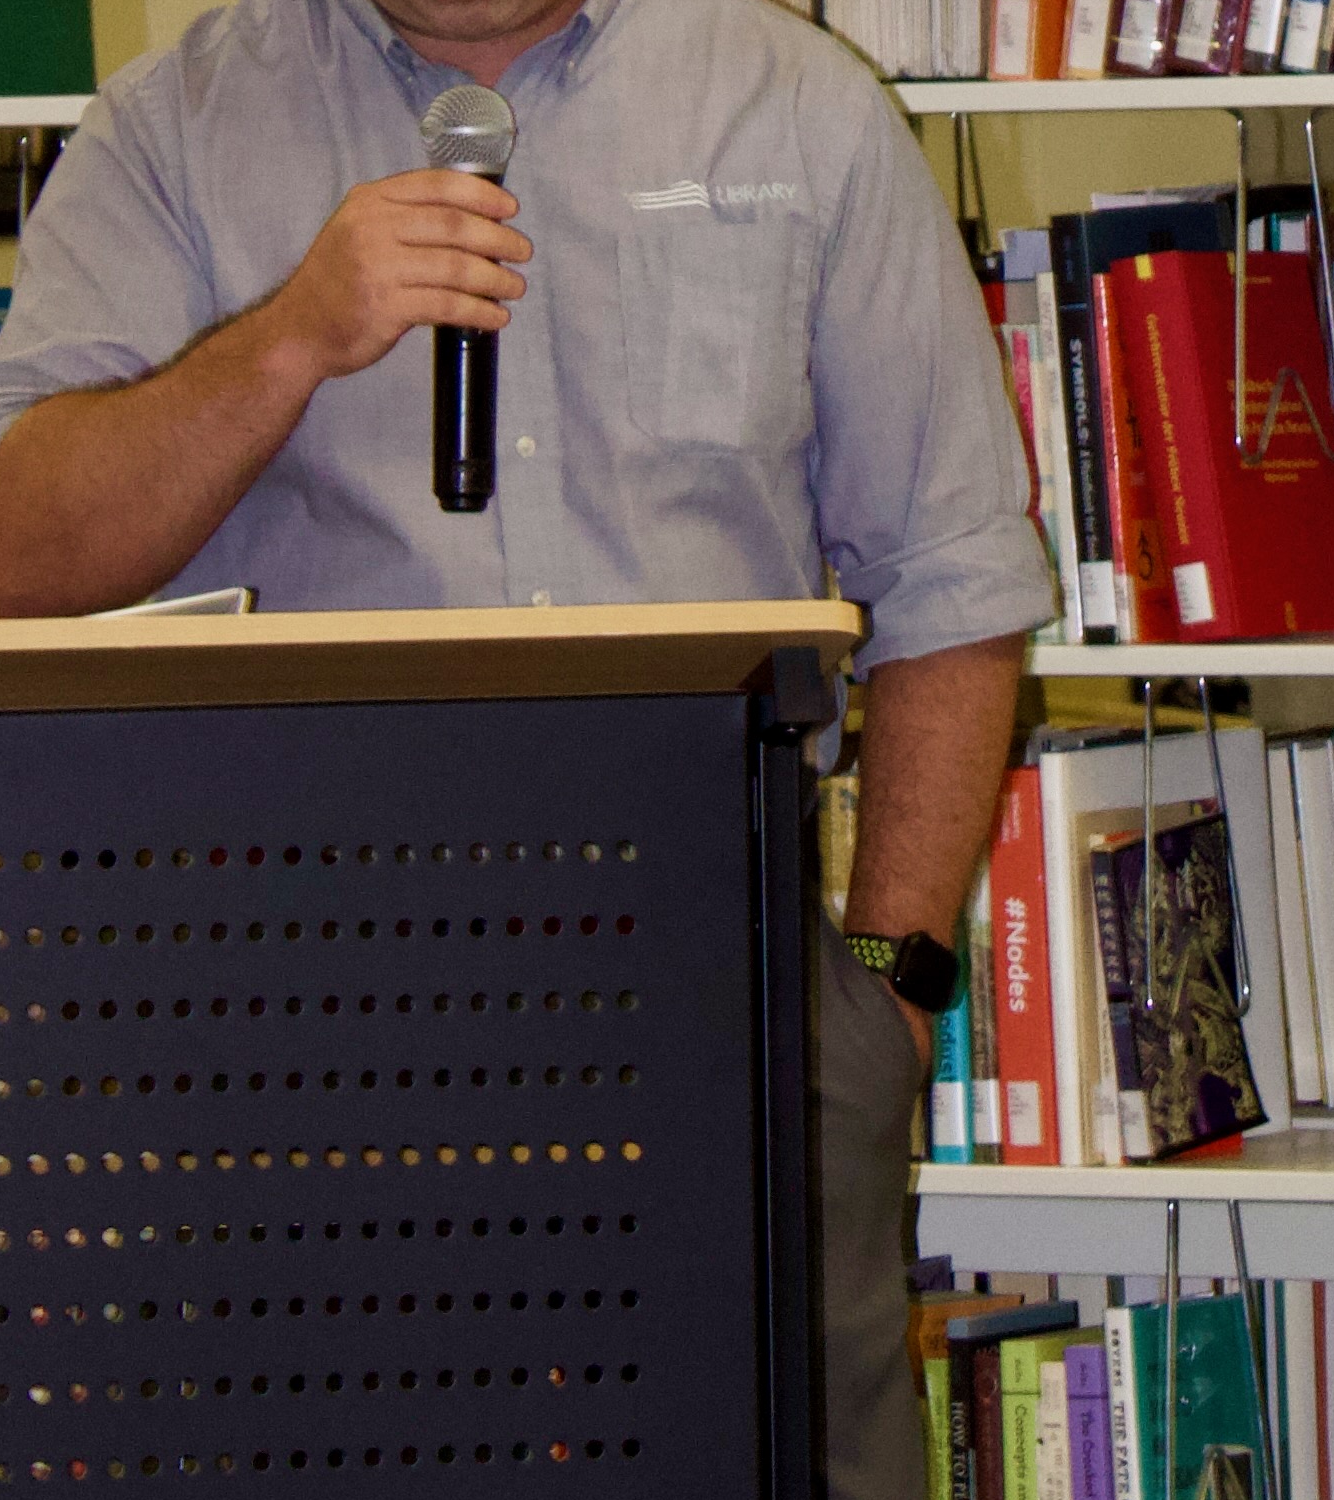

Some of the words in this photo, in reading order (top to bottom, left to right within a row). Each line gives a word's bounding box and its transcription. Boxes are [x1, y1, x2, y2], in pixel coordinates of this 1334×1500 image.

[1005, 898, 1029, 1012] #Nodes
[1013, 1405, 1029, 1479] Concepts
[1113, 1402, 1128, 1442] THE
[1115, 1446, 1130, 1494] FATE
